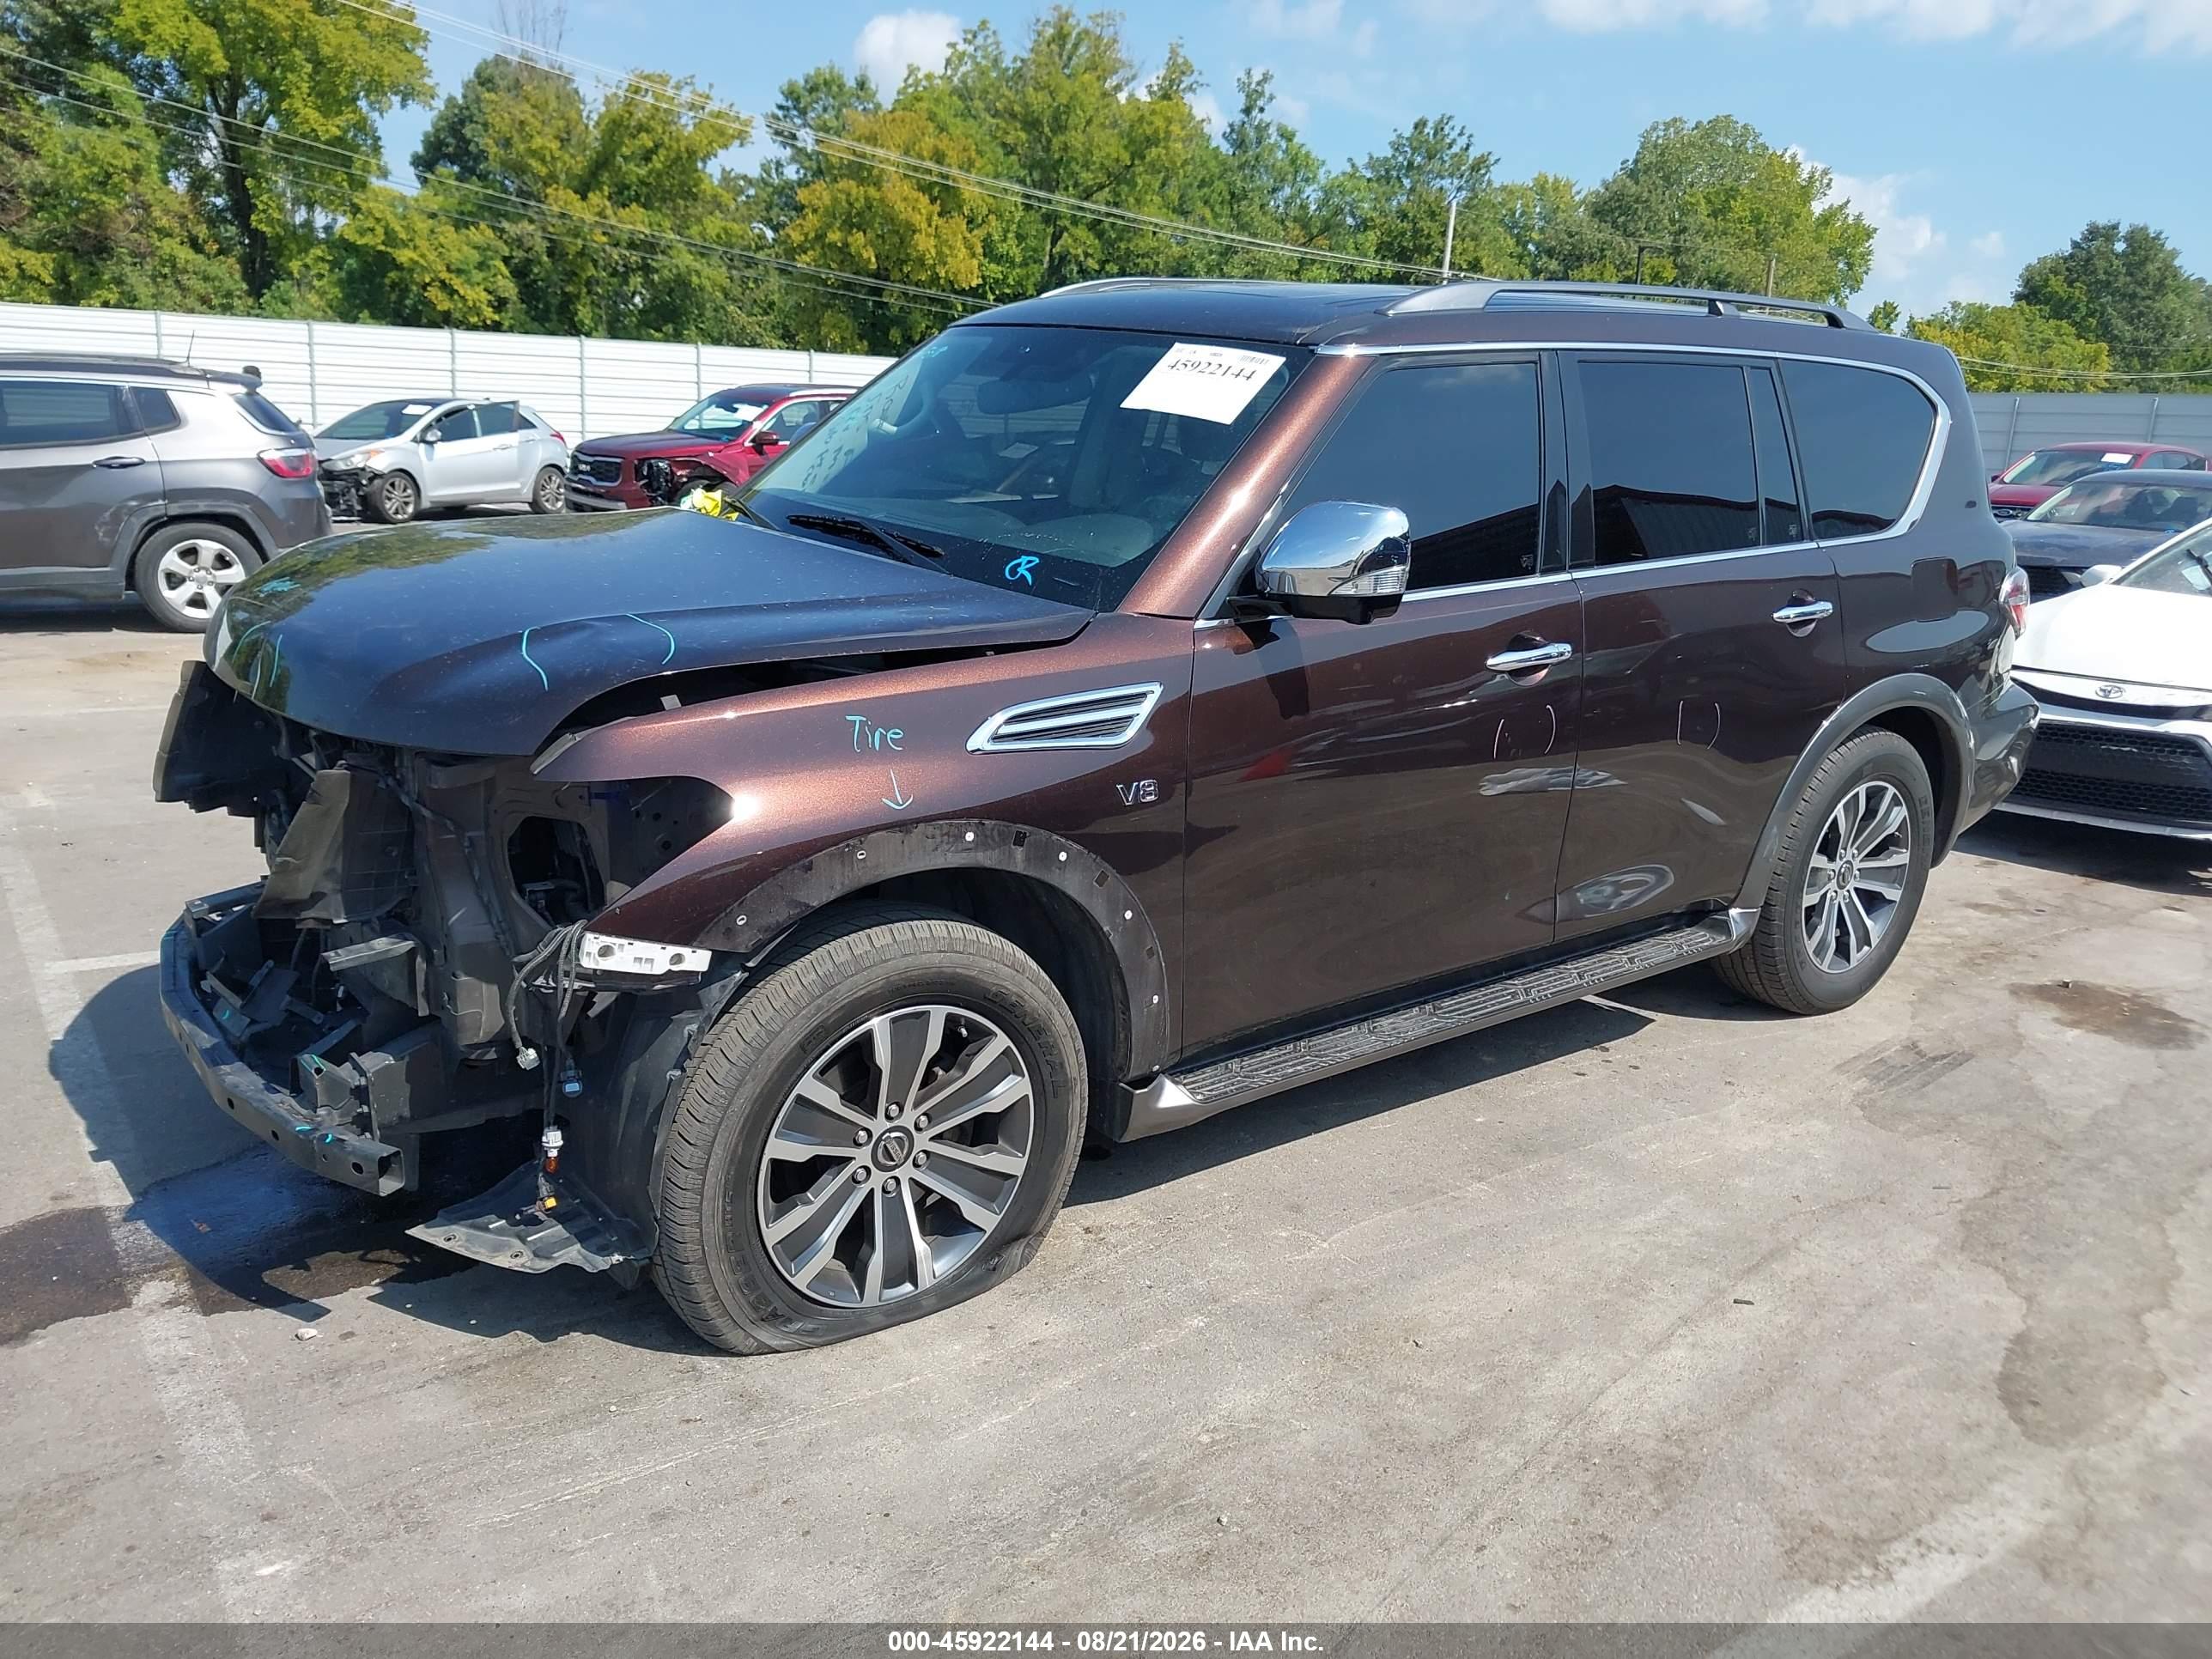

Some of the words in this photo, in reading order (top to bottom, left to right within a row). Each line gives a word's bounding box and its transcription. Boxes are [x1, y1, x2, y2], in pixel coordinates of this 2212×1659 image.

[1167, 359, 1257, 380] 45922144
[845, 714, 905, 753] Tire
[1116, 779, 1159, 806] V8
[984, 989, 1067, 1099] GENERAL
